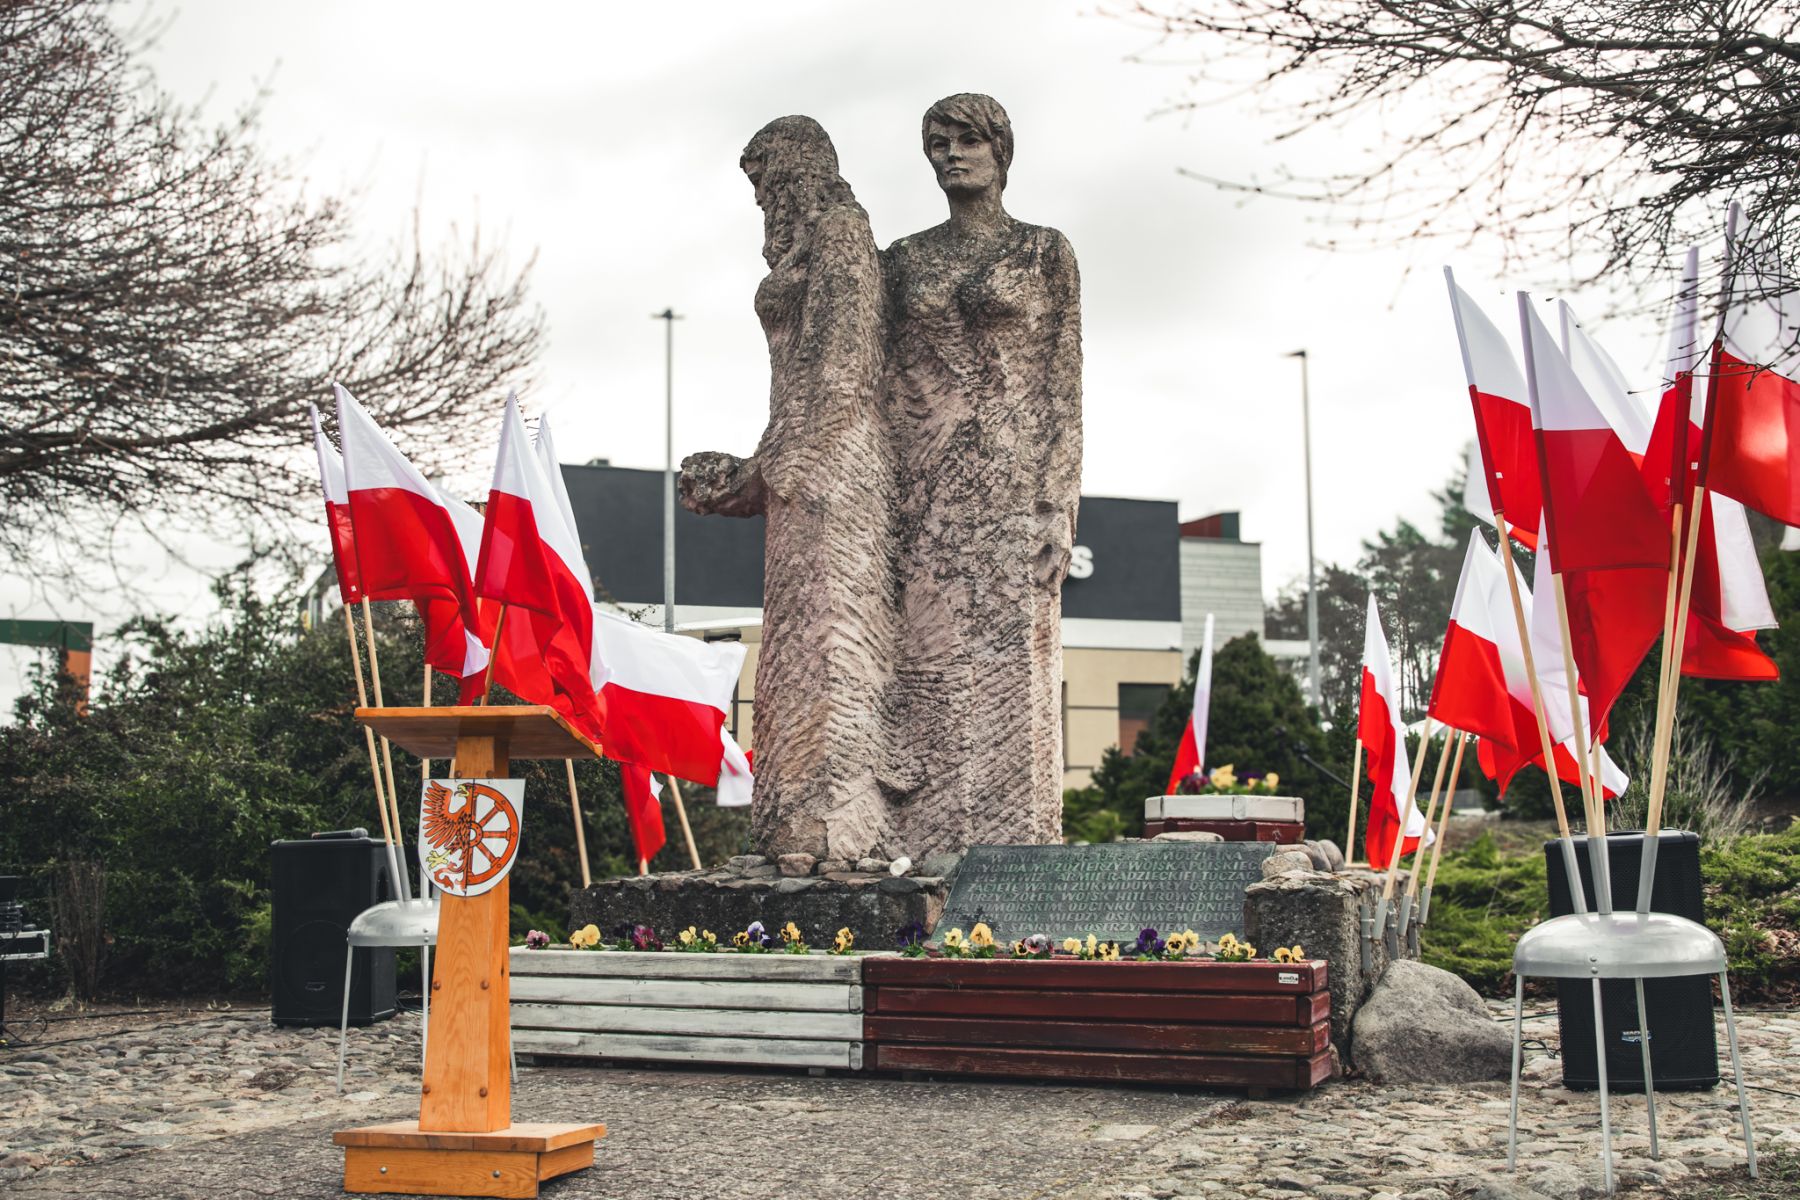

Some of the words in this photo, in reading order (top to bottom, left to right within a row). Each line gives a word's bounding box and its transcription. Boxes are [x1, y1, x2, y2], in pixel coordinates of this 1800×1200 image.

[1025, 881, 1068, 892] WALKI
[1061, 891, 1113, 901] WOJSK
[1115, 891, 1235, 901] HITLEROWSKICH
[1068, 901, 1136, 912] ODCINKU
